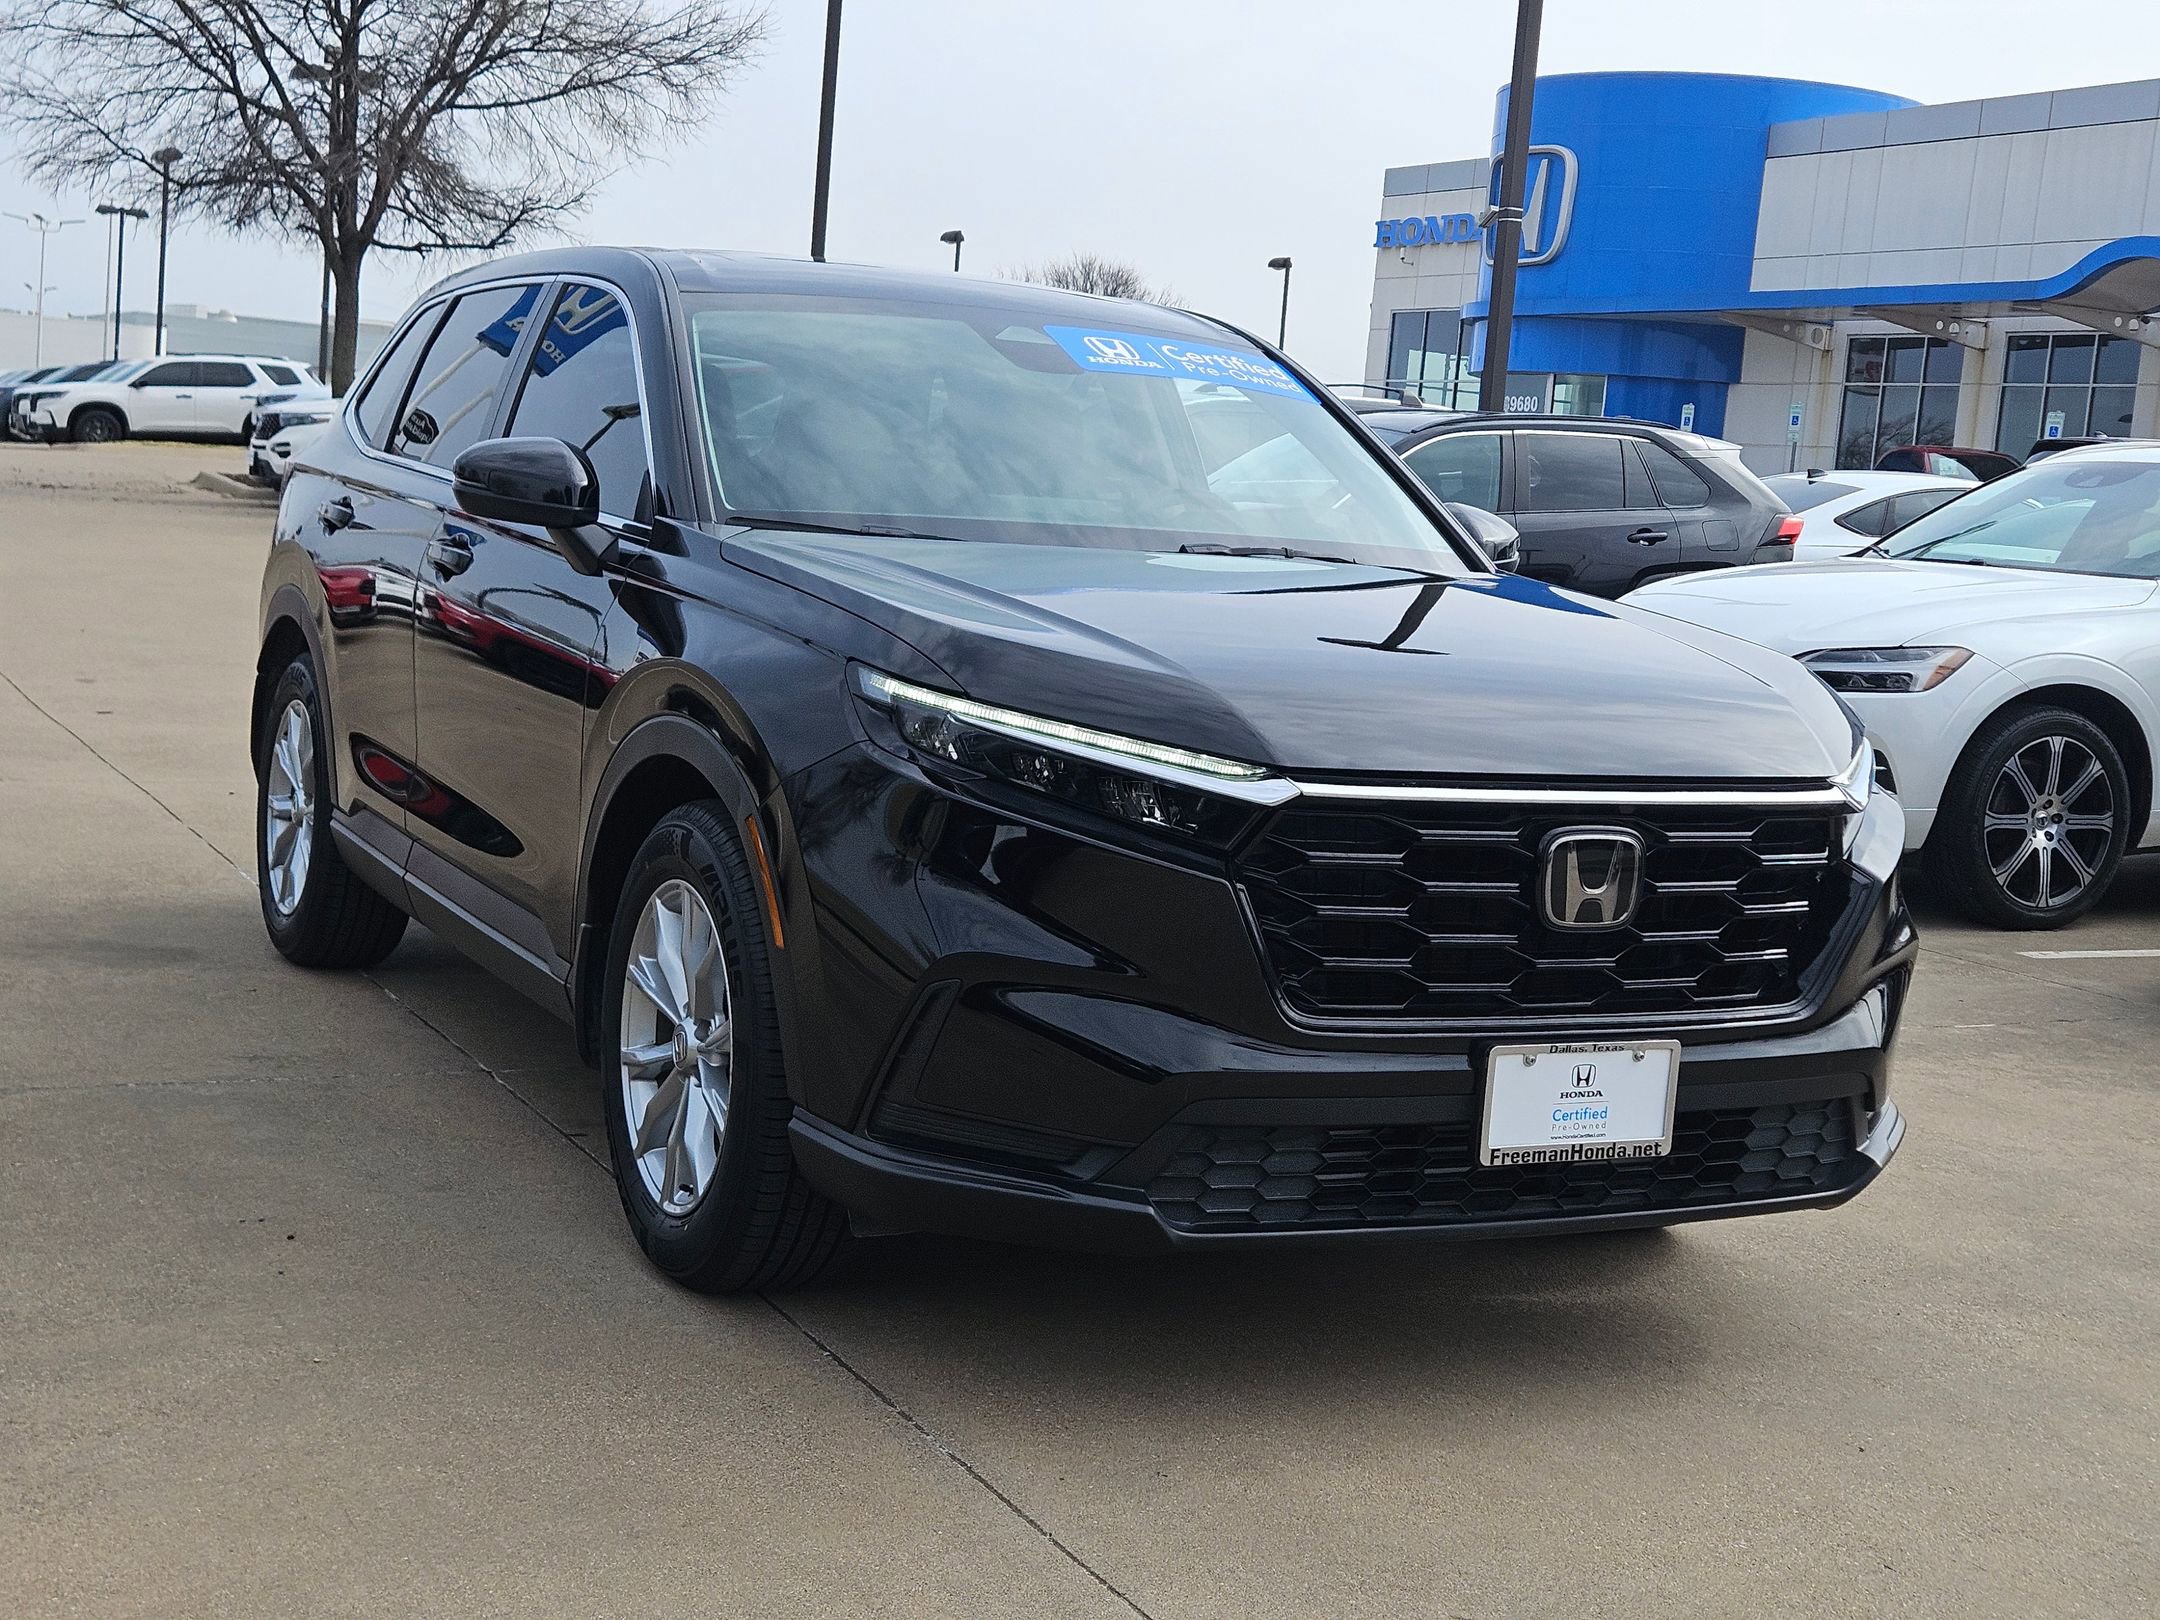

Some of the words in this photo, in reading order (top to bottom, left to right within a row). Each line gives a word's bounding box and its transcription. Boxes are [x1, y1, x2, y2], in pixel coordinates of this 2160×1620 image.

[1086, 356, 1164, 368] HONDA
[1161, 344, 1290, 381] Certified
[1181, 361, 1302, 393] Pre-Owned
[1591, 1043, 1625, 1052] Texas
[1559, 1090, 1604, 1099] HONDA
[1552, 1106, 1608, 1121] Certified
[1551, 1121, 1606, 1131] Pre-Owned
[1489, 1142, 1662, 1165] FreemanHonda.net
